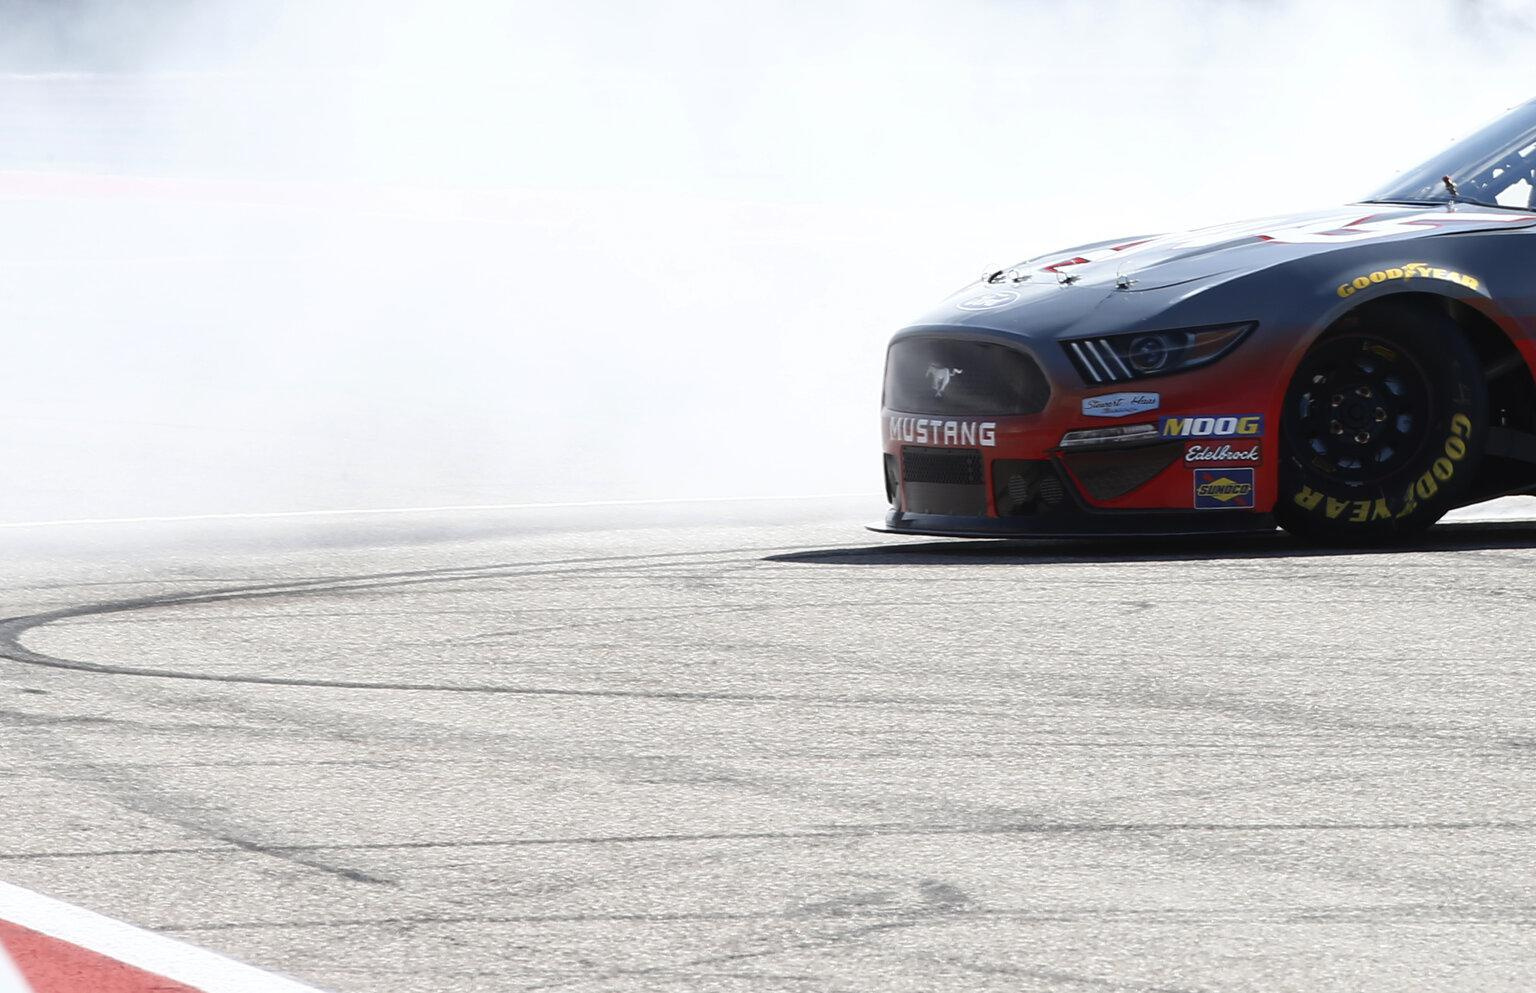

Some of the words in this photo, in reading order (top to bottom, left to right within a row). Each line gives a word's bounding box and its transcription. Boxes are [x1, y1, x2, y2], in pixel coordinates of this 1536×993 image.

[1337, 262, 1480, 298] GOODYEAR
[888, 416, 997, 447] MUSTANG
[1162, 416, 1261, 436] MOOG
[1185, 445, 1260, 461] Edelbrock
[1199, 483, 1251, 496] SUNOCO
